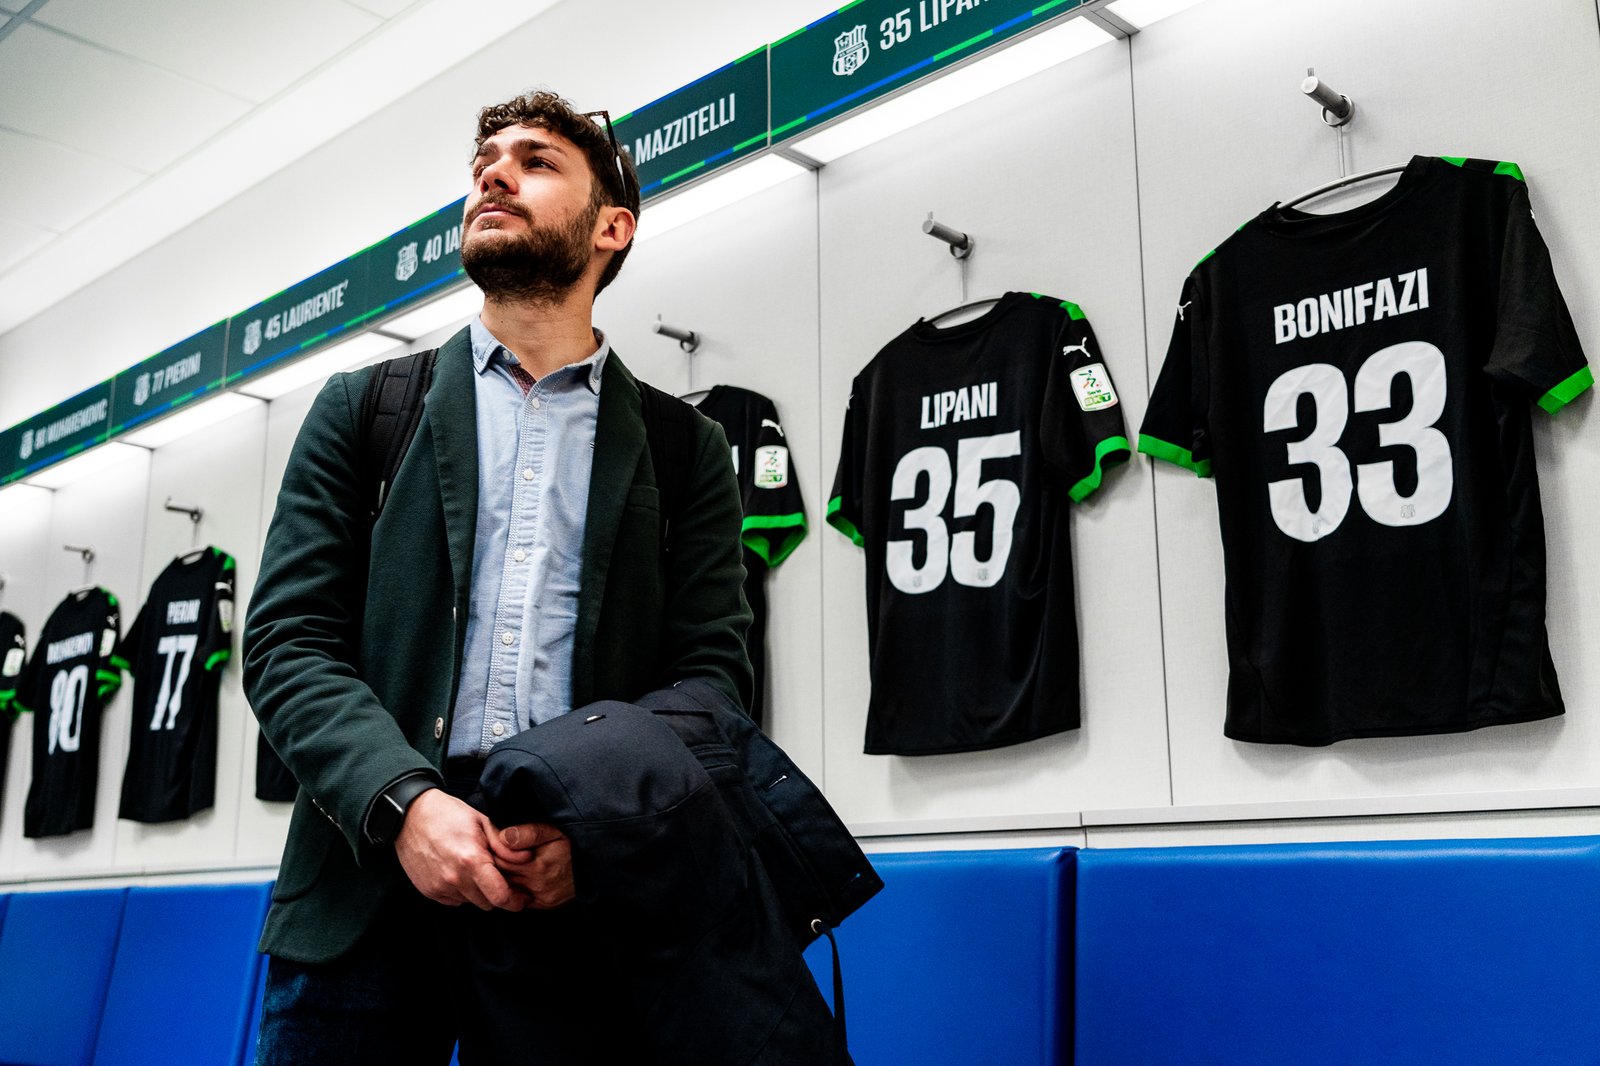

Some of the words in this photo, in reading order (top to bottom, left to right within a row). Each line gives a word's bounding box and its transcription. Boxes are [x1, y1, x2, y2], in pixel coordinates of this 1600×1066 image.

[879, 7, 912, 51] 35
[635, 92, 736, 167] MAZZITELLI
[422, 235, 442, 264] 40
[264, 314, 281, 341] 45
[1273, 267, 1430, 345] BONIFAZI
[151, 367, 166, 395] 77
[165, 351, 202, 389] PIERINI
[920, 381, 998, 430] LIPANI
[1263, 340, 1454, 543] 33
[885, 430, 1022, 595] 35
[149, 634, 199, 731] 77
